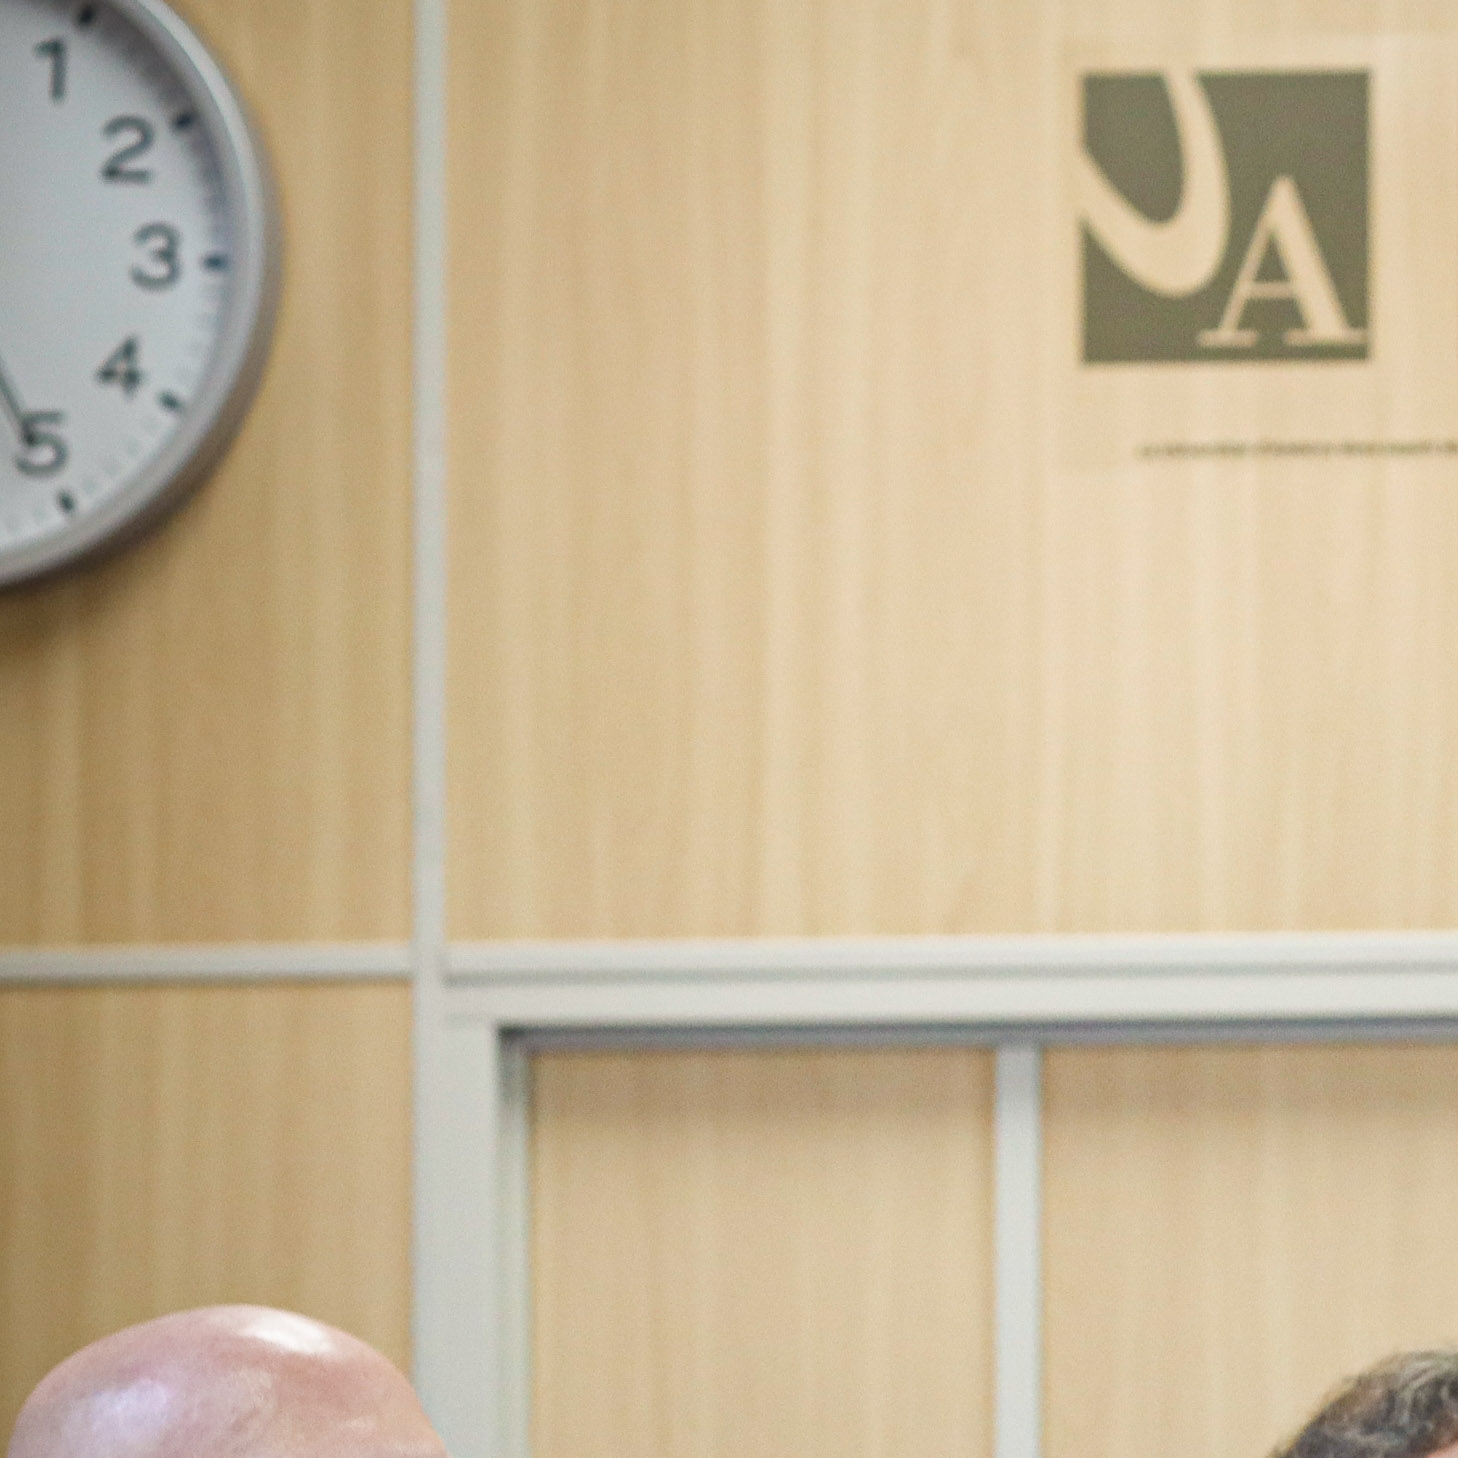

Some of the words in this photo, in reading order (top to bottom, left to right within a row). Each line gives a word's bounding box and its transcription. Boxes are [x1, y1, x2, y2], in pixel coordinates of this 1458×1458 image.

[34, 37, 68, 101] 1
[101, 115, 154, 184] 2
[131, 221, 180, 290] 3
[96, 334, 142, 398] 4
[15, 410, 68, 476] 5
